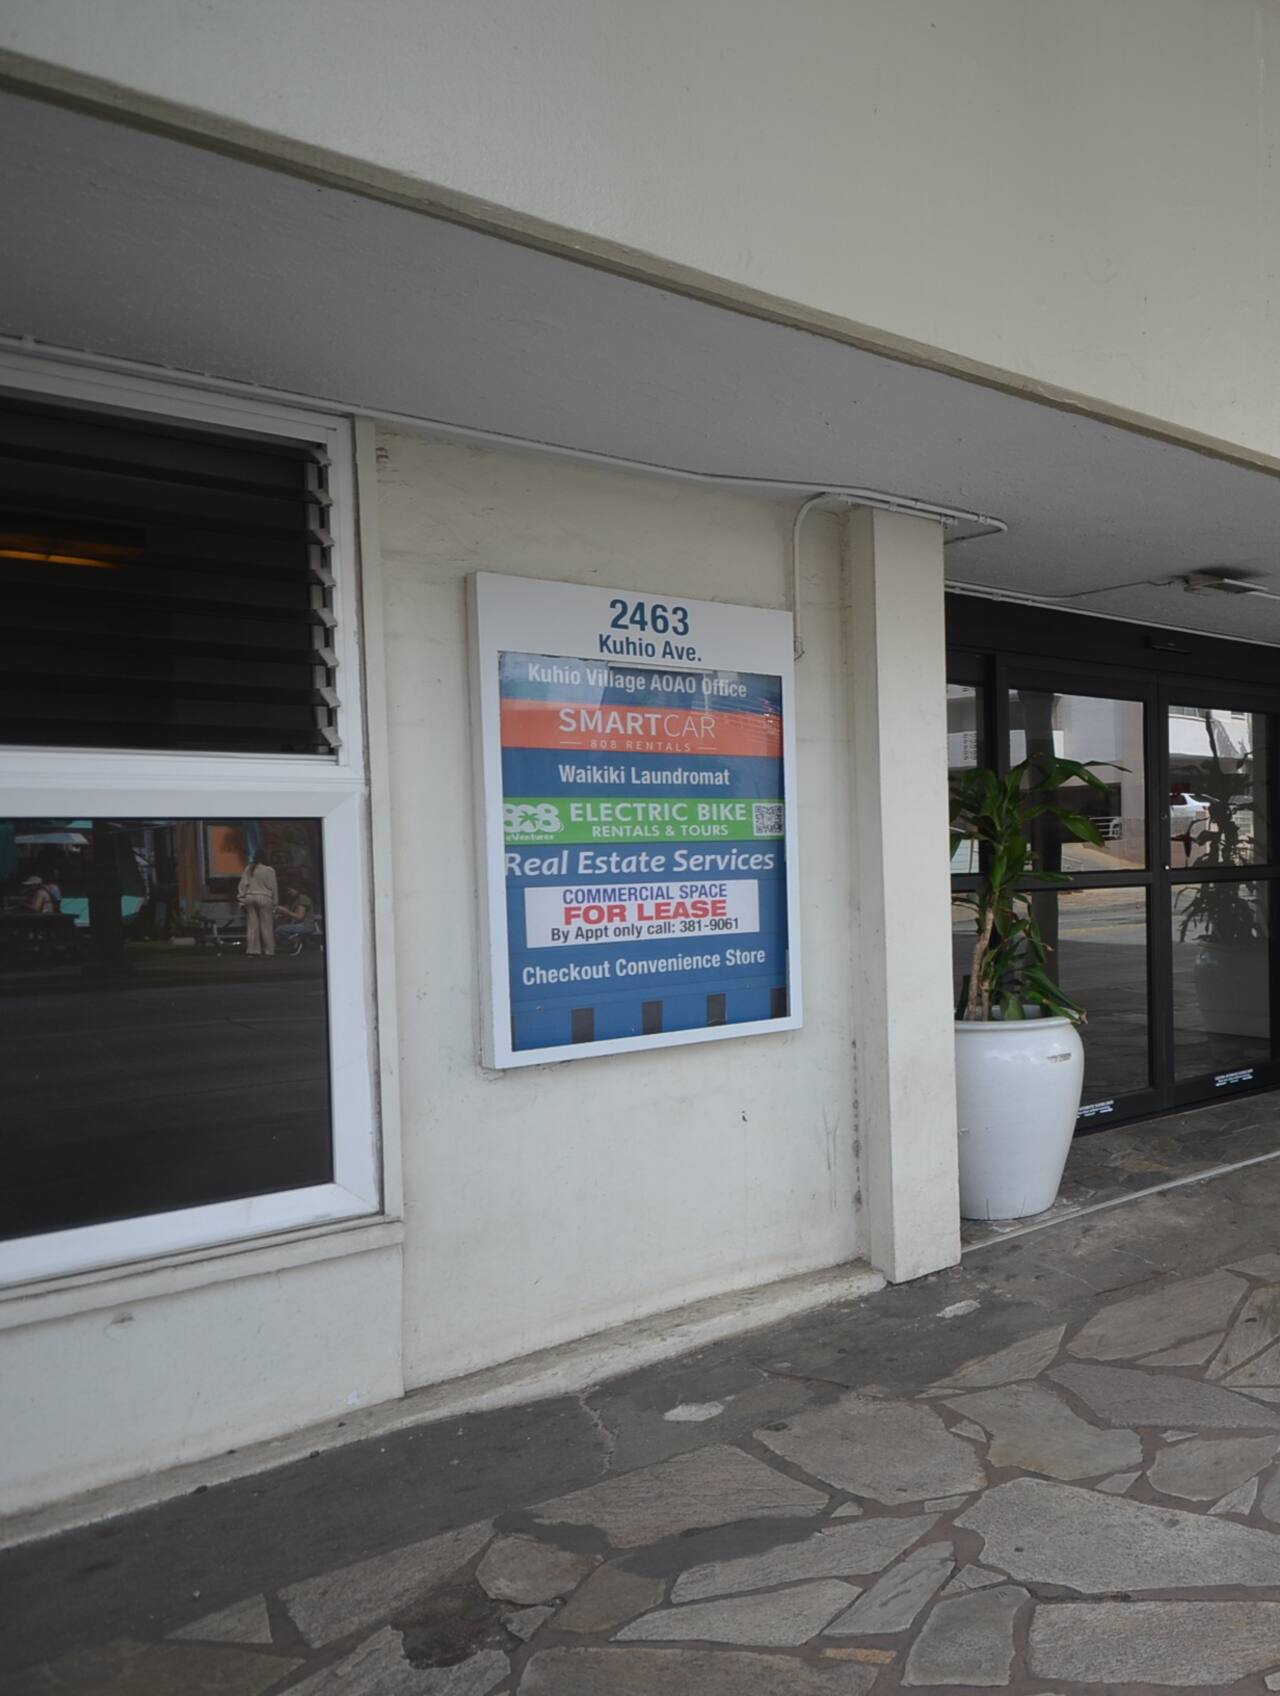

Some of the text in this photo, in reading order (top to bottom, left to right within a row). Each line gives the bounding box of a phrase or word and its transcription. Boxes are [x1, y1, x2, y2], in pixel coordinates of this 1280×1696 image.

[609, 599, 690, 636] 2463
[599, 634, 702, 662] Kuhio Ave.
[528, 663, 747, 698] Kuhio Village AOAO Office
[559, 708, 716, 738] SMARTCAR
[590, 739, 691, 752] 808 RENTALS
[558, 764, 730, 785] Waikiki Laundromat
[569, 803, 746, 822] ELECTRIC BIKE
[592, 825, 729, 838] RENTALS & TOURS
[505, 848, 775, 876] Real Estate Services
[562, 883, 728, 904] COMMERCIAL SPACE
[564, 899, 727, 925] FOR LEASE
[551, 917, 739, 943] By Appt only call: 381-9061
[522, 949, 766, 986] Checkout Convenience Store
